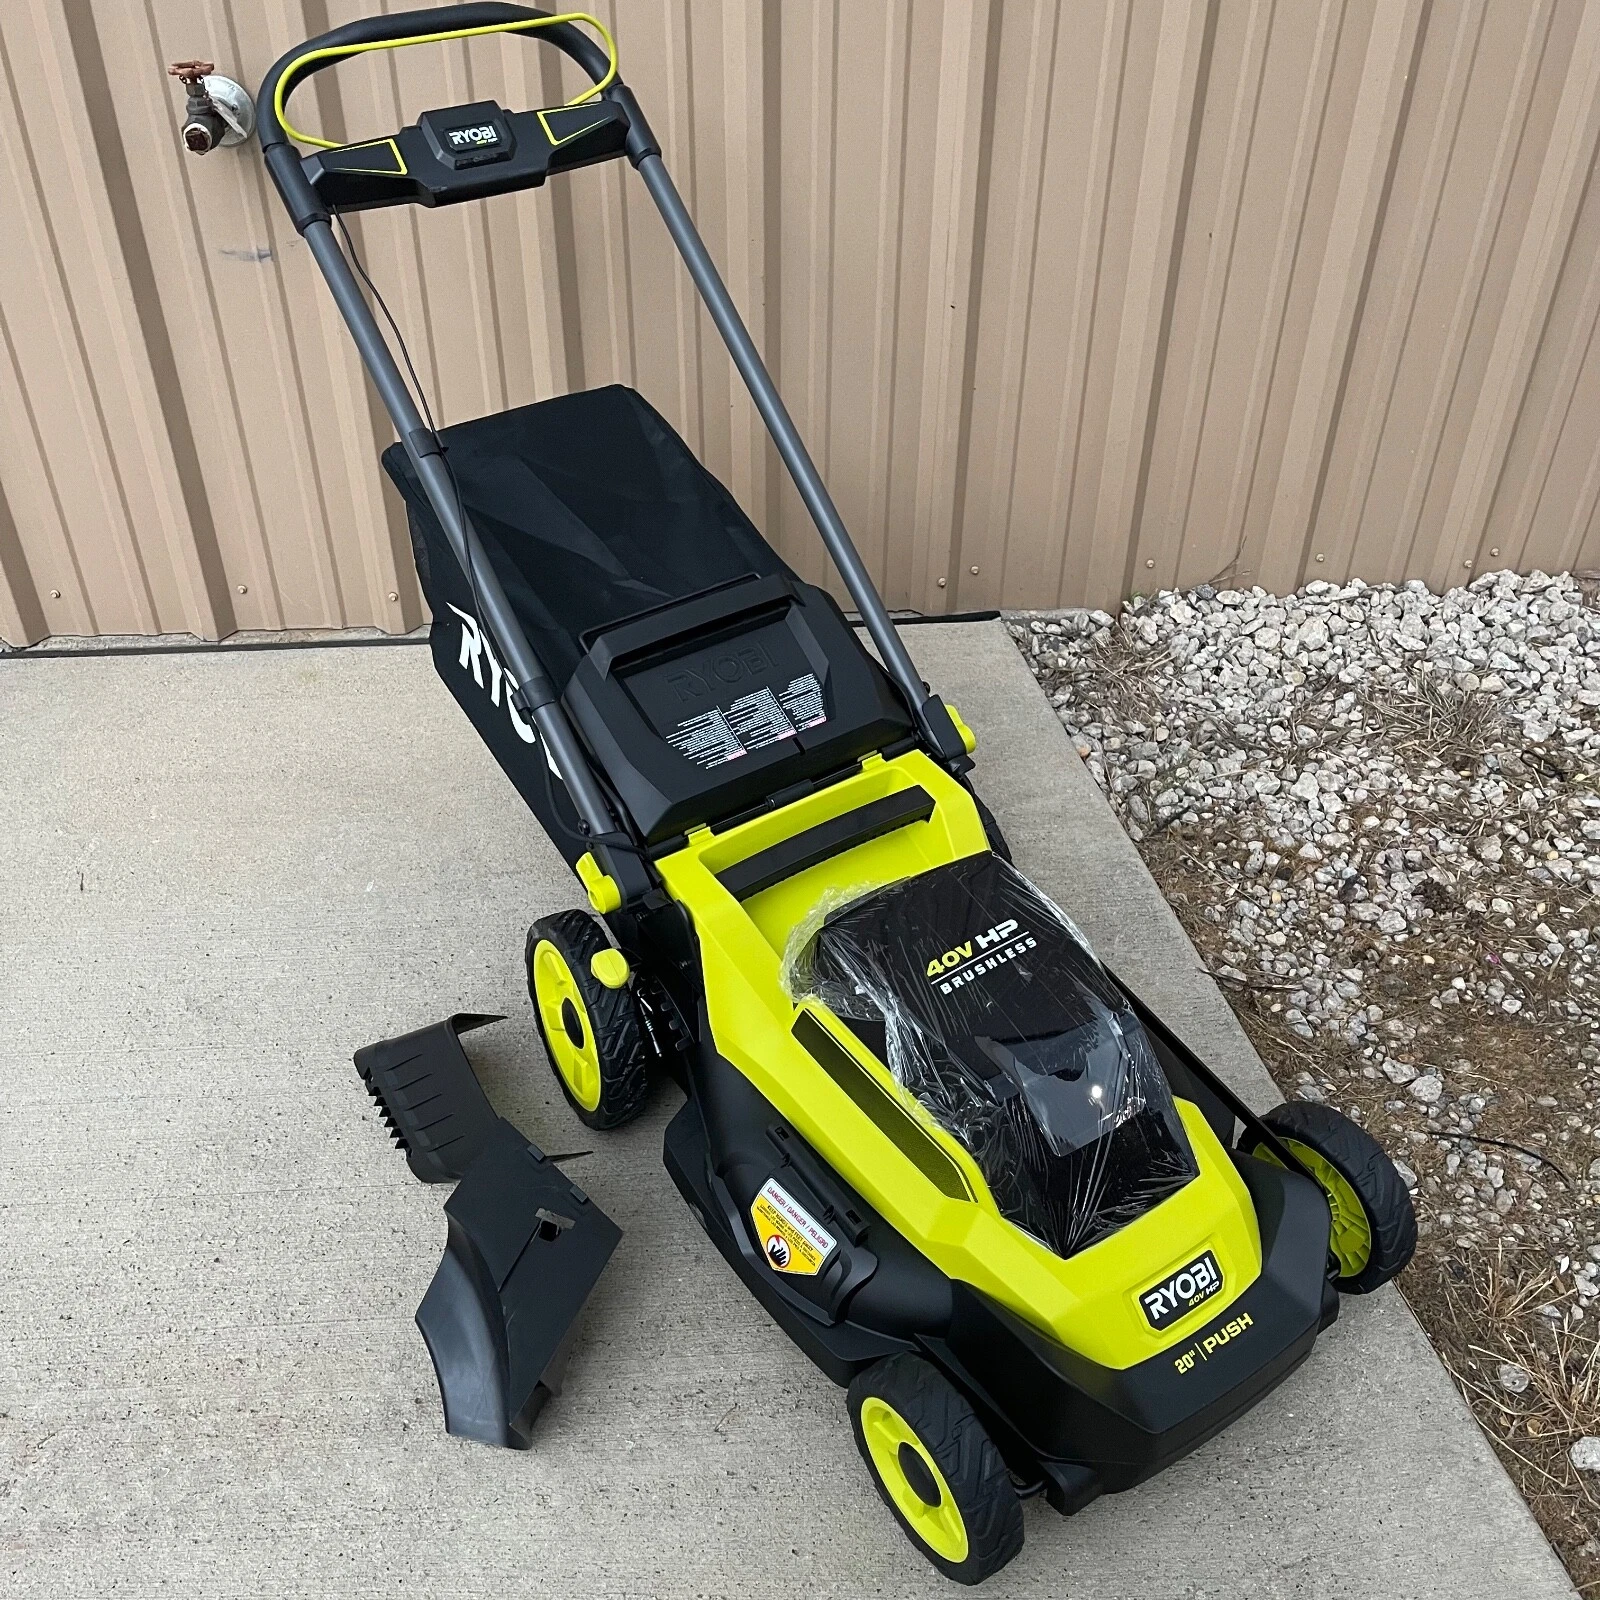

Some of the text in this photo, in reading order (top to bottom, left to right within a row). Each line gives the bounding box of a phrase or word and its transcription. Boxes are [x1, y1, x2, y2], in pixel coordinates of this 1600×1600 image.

[448, 125, 497, 145] RYOBI
[663, 641, 778, 702] RYOBI
[926, 918, 1019, 977] 40V HP
[939, 937, 1037, 995] BRUSHLESS
[766, 1186, 786, 1207] DANGER
[786, 1206, 807, 1227] DANGER
[808, 1227, 829, 1249] PELIGRO
[1144, 1256, 1218, 1320] RYOBI
[1188, 1281, 1220, 1307] 40V HP
[1174, 1312, 1254, 1374] 20" PUSH
